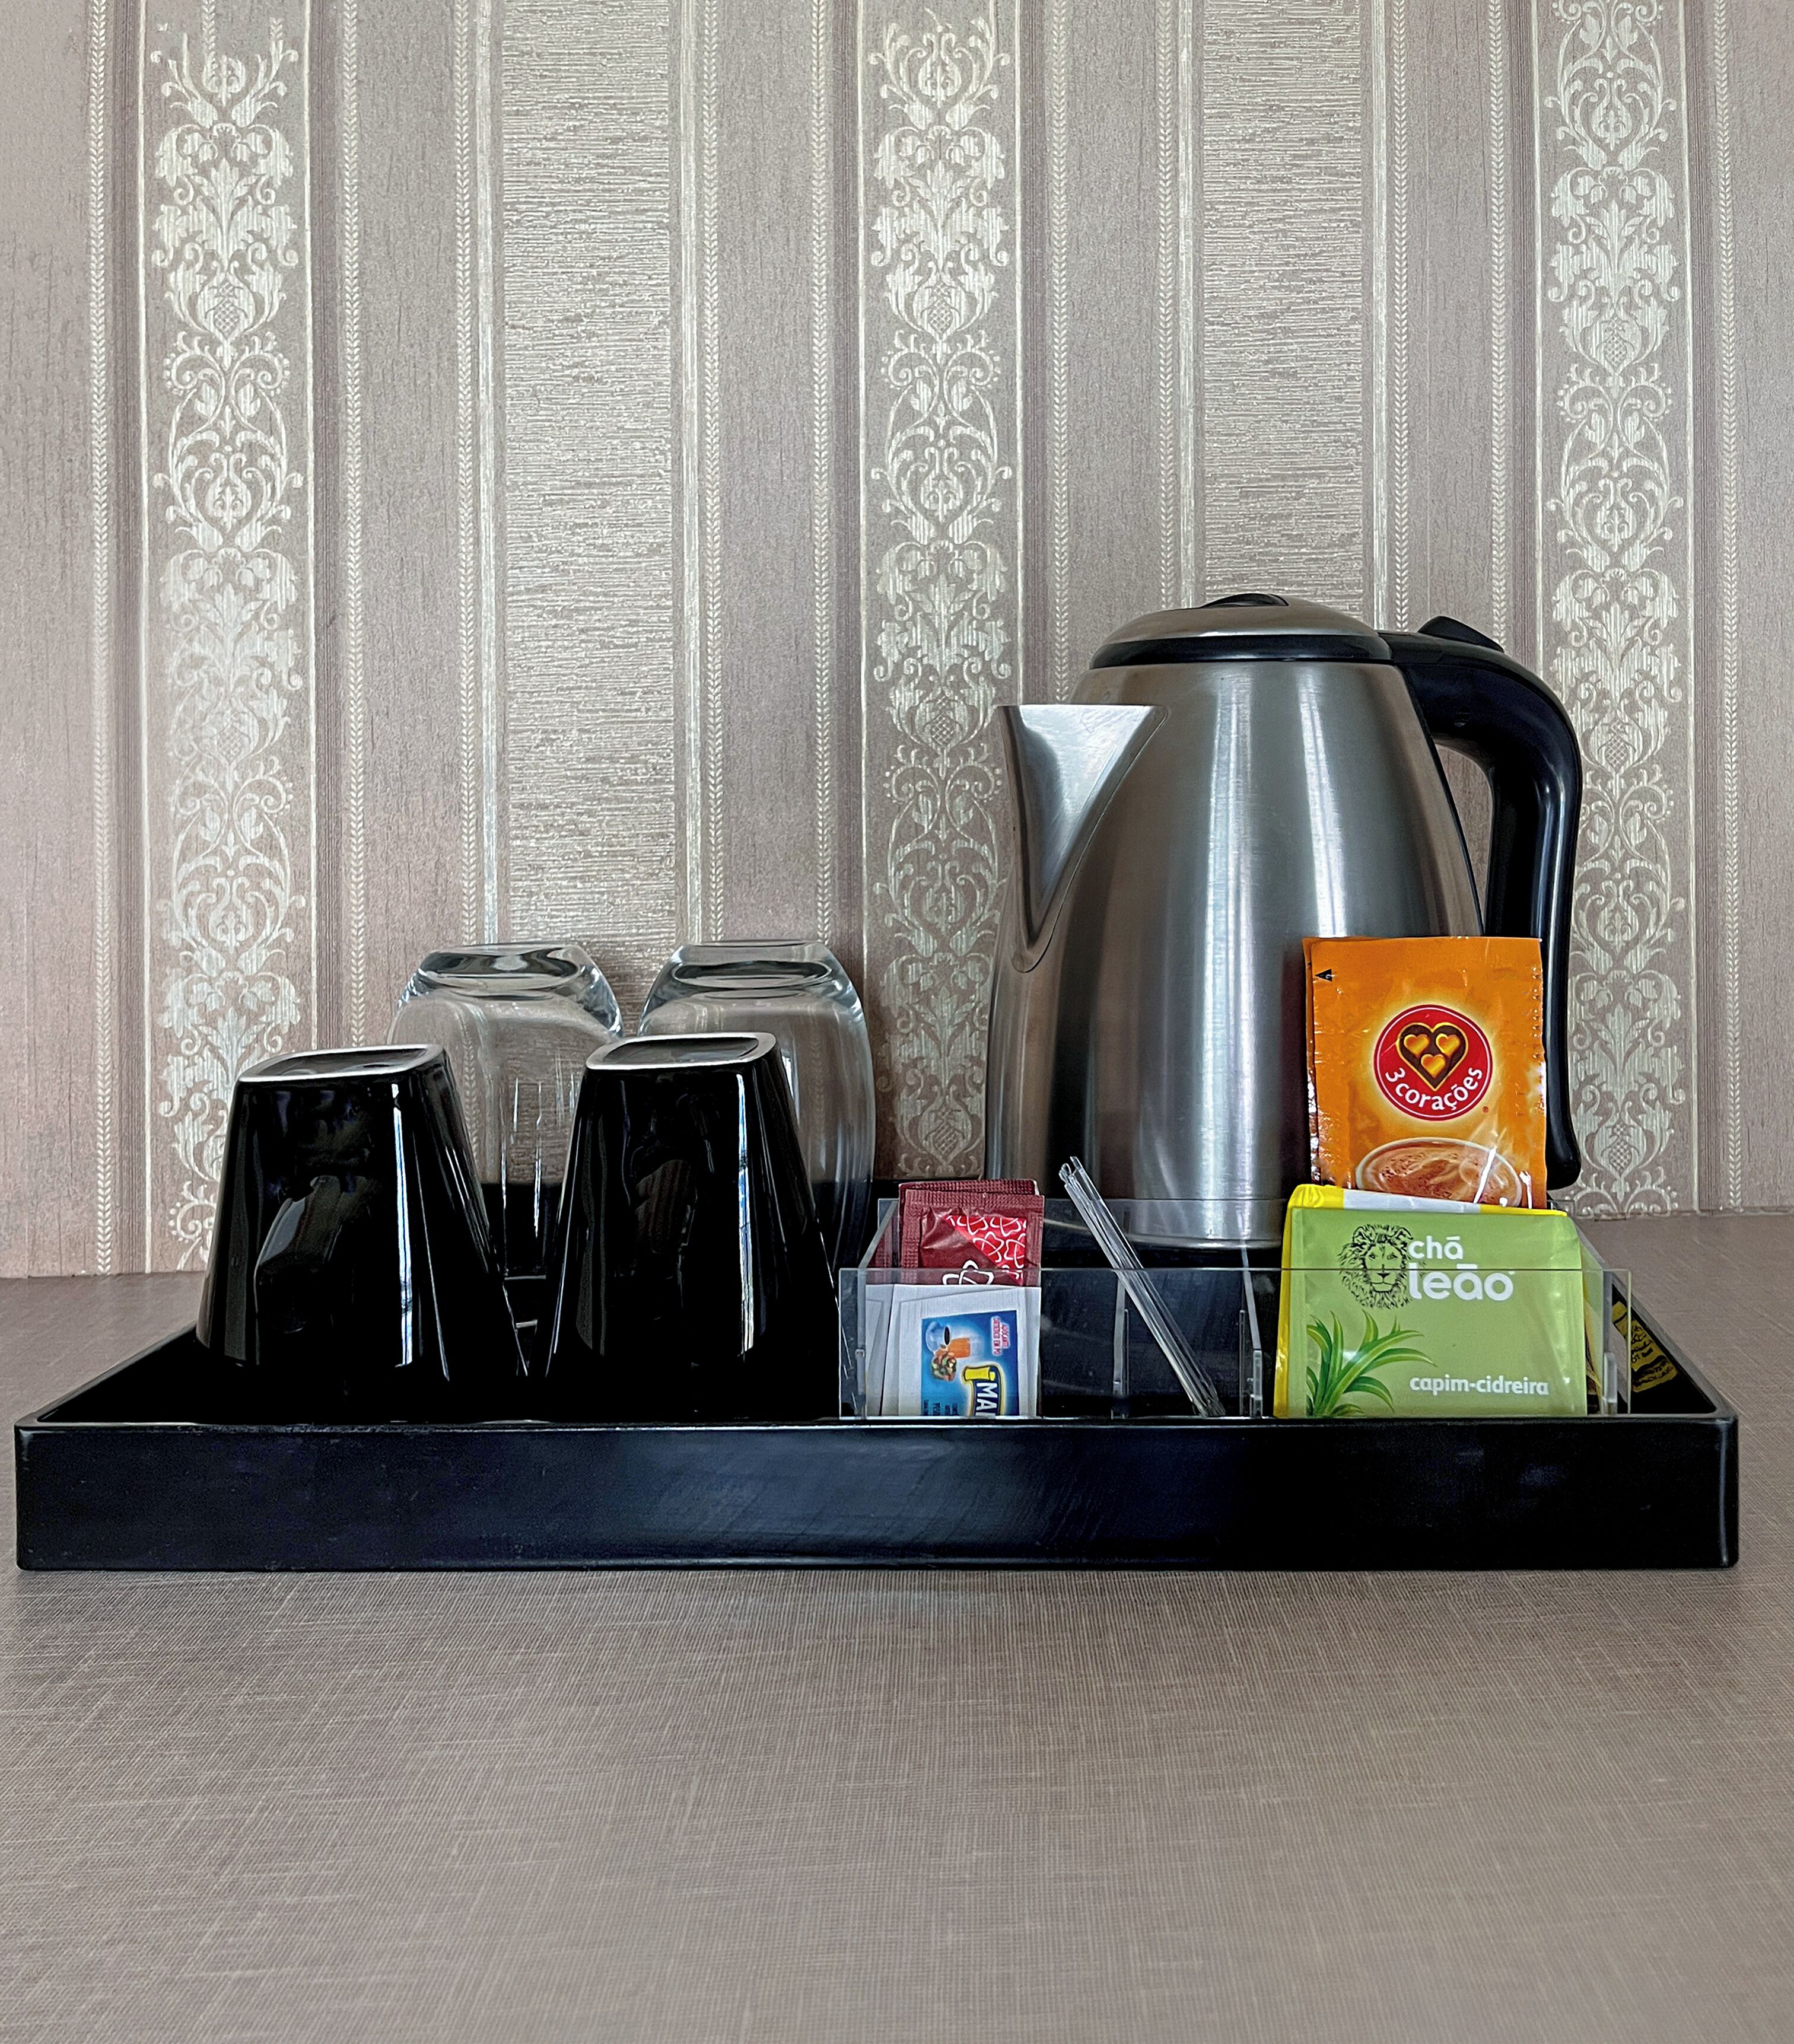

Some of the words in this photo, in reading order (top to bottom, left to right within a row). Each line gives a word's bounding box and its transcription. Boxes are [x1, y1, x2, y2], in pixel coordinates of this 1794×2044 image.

[1385, 1068, 1405, 1082] 3
[1395, 1068, 1482, 1110] corações
[1410, 1374, 1549, 1396] capim-cidreira
